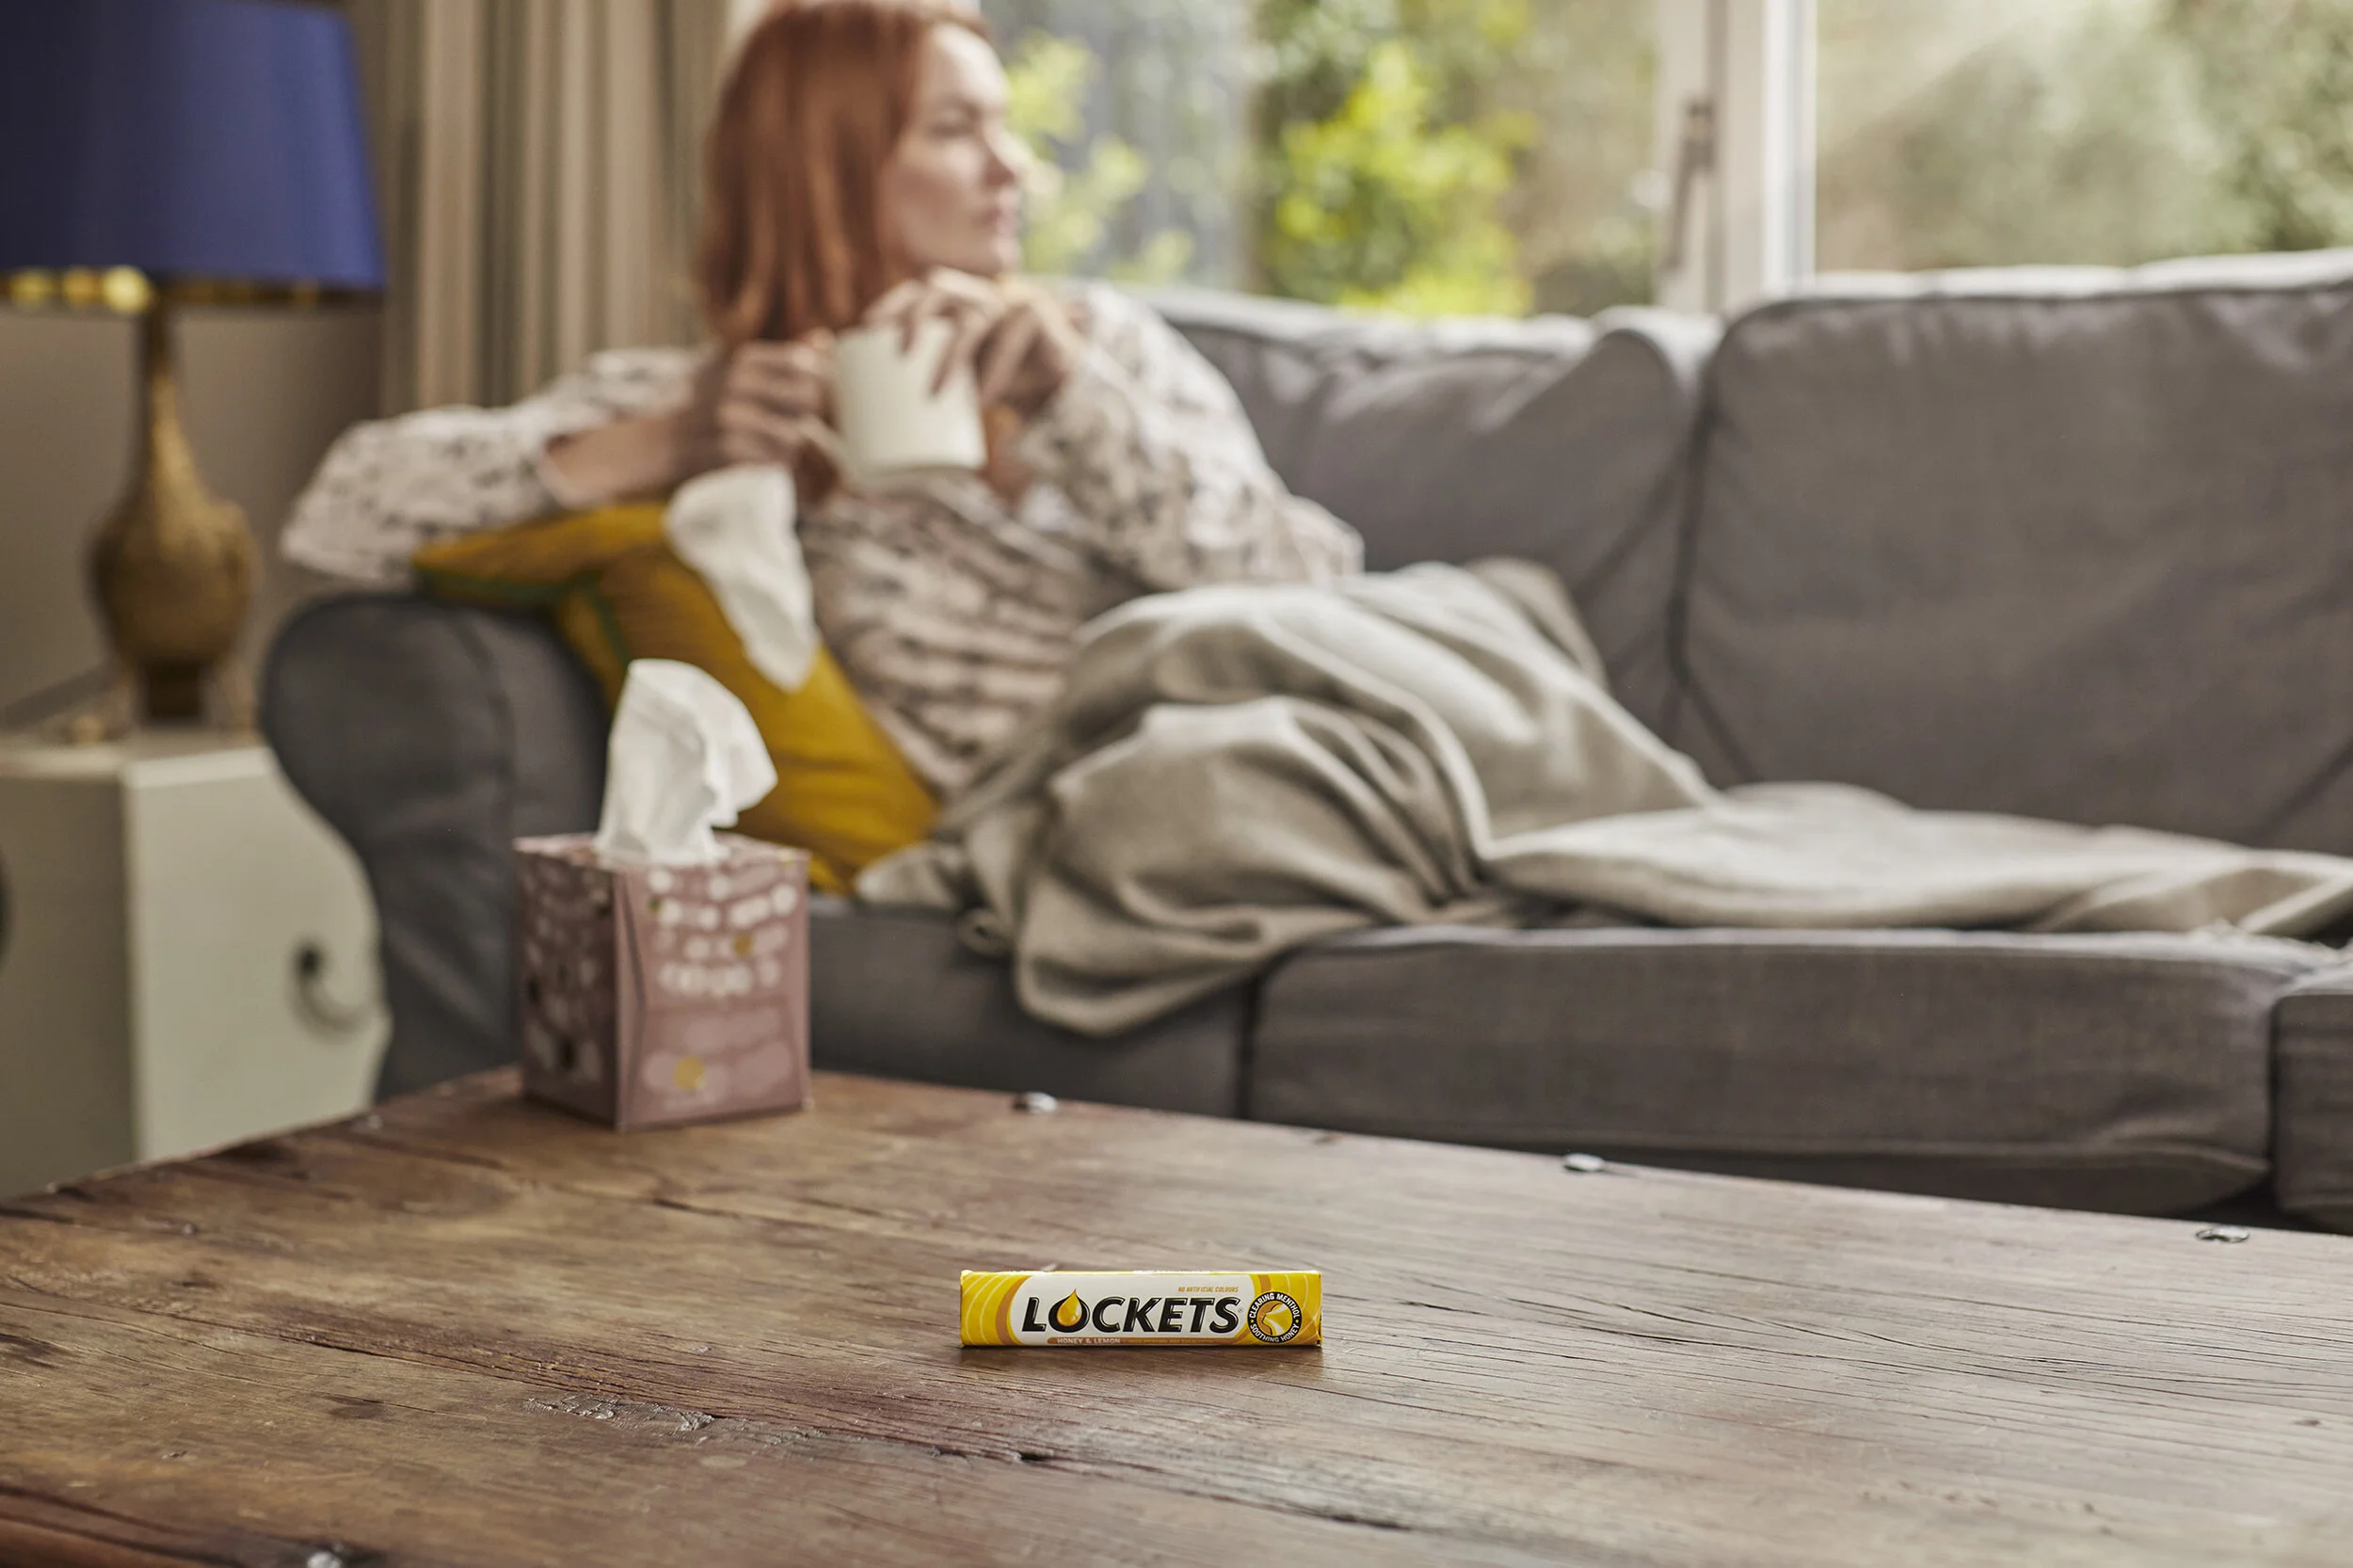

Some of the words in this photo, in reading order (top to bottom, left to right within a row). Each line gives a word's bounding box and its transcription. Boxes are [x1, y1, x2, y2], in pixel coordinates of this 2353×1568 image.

[1021, 1295, 1241, 1334] LOCKETS
[1248, 1292, 1275, 1319] CLEARING
[1276, 1293, 1301, 1319] MENTHOL
[1250, 1323, 1280, 1342] SOOTHING
[1280, 1323, 1300, 1341] HONEY
